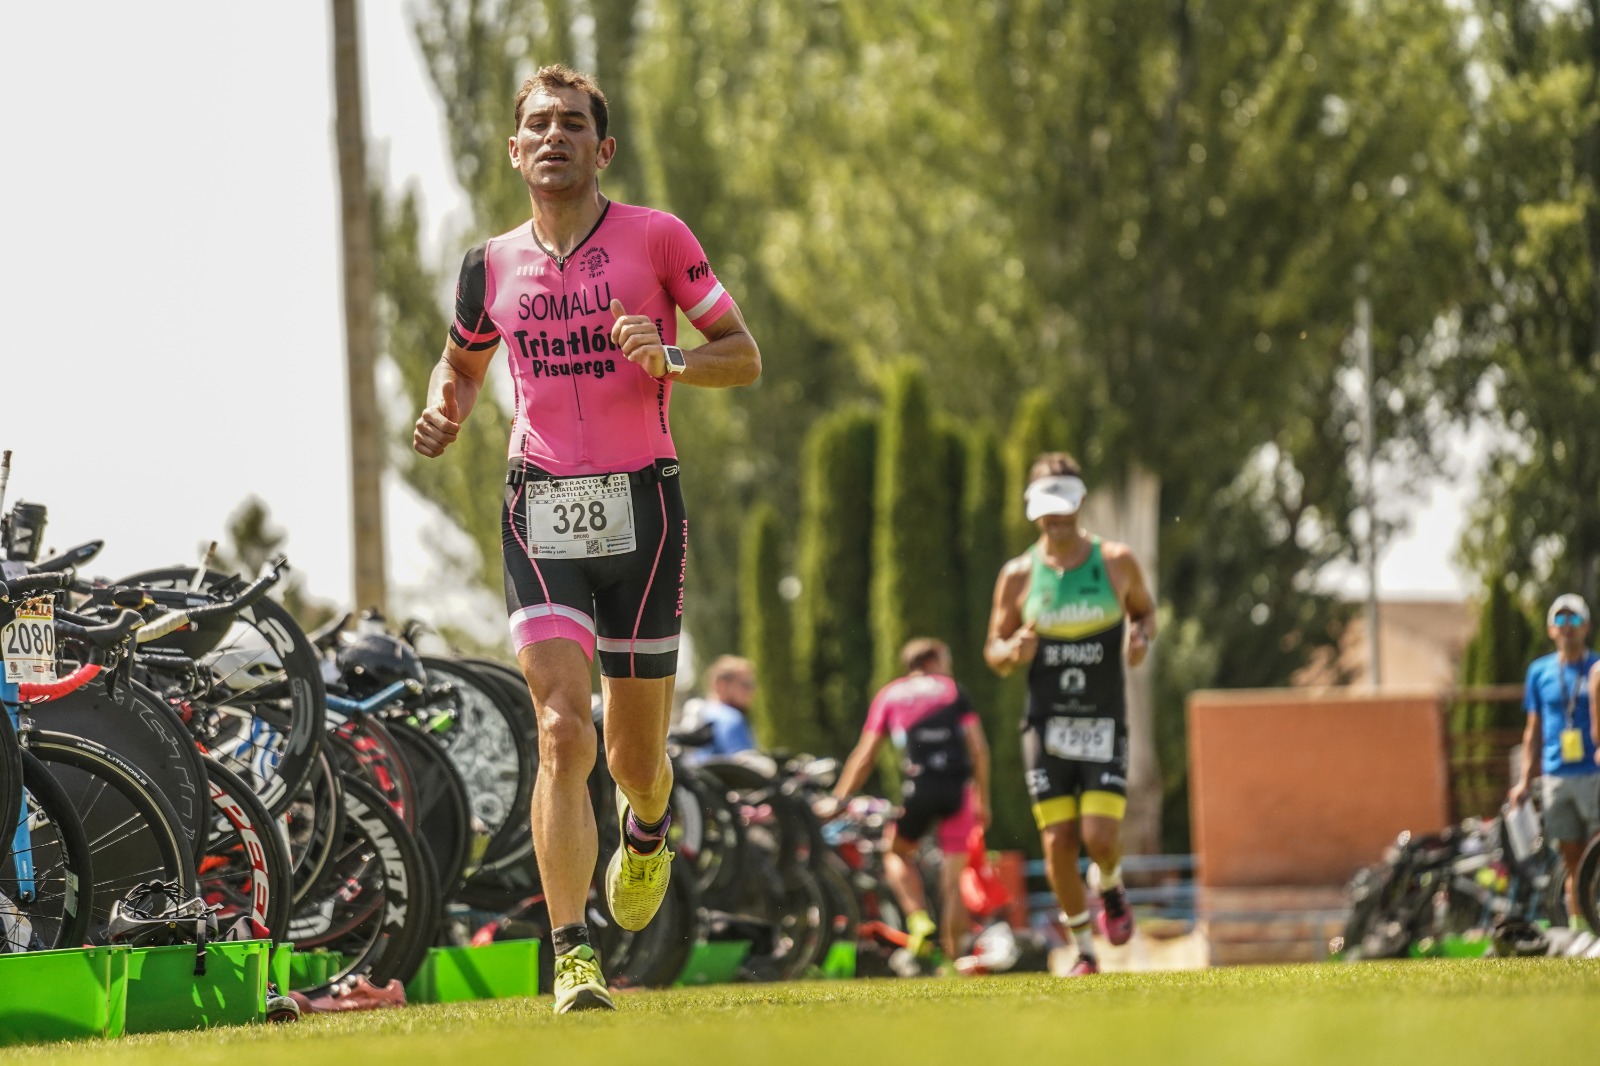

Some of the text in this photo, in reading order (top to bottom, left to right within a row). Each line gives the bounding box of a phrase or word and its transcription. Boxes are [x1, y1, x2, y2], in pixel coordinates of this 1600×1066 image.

[518, 281, 611, 321] SOMALU
[532, 358, 615, 378] Pisuerga
[550, 485, 585, 493] TRIATLON
[550, 490, 590, 499] CASTILLA
[601, 486, 627, 494] LEON
[553, 501, 607, 534] 328
[5, 622, 54, 657] 2080
[209, 780, 270, 926] SPEE
[384, 901, 408, 928] X
